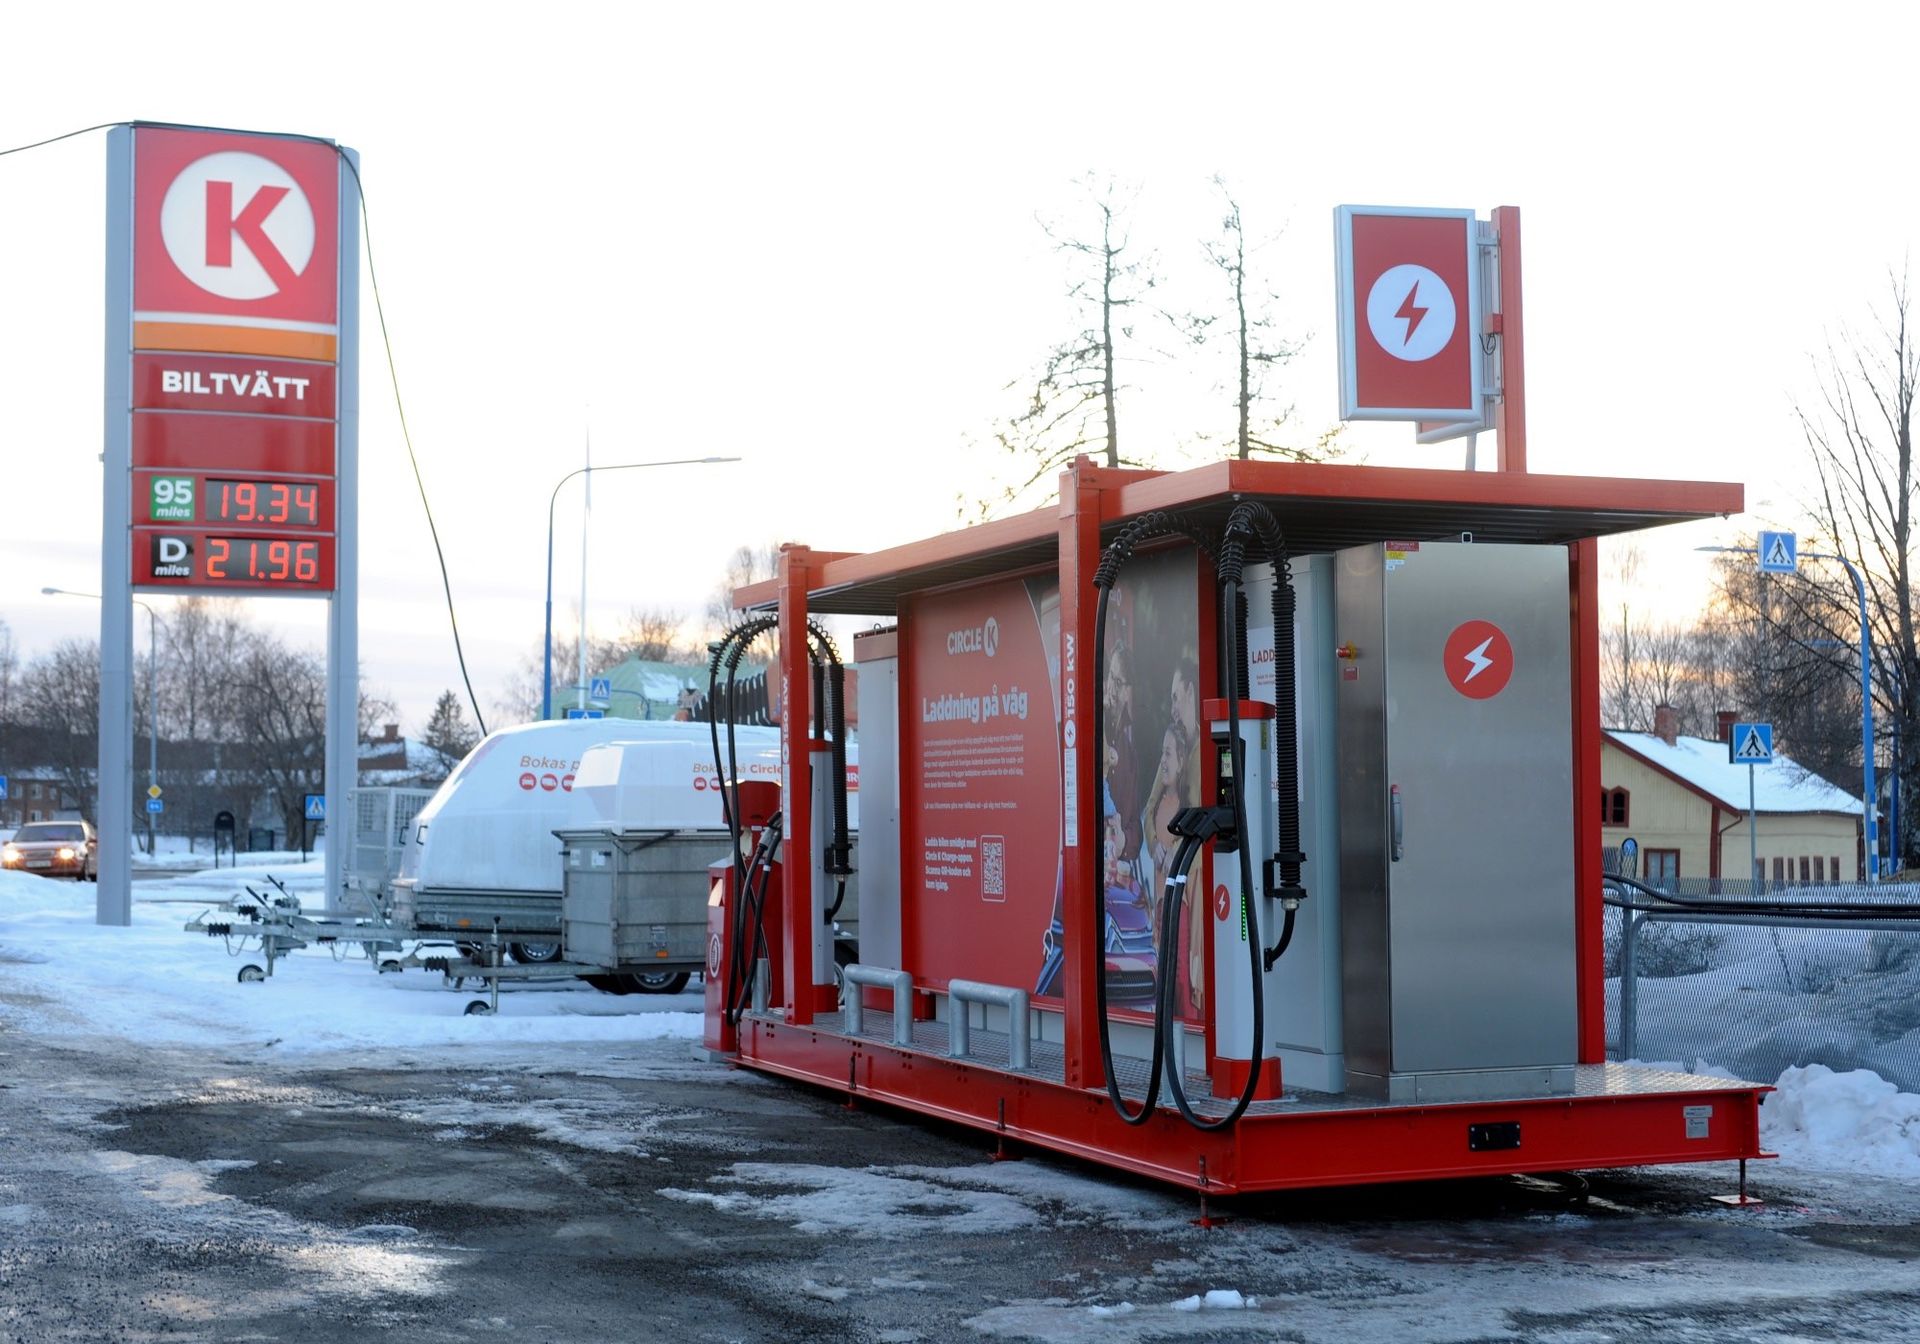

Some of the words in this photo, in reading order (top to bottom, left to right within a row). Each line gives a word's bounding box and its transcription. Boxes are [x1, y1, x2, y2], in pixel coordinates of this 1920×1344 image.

[205, 180, 300, 291] K
[162, 370, 310, 400] BILTVÄTT
[153, 480, 193, 505] 95
[220, 483, 317, 522] 19.34
[156, 506, 190, 518] miles
[159, 538, 188, 563] D
[206, 539, 317, 580] 21.96
[154, 564, 190, 577] miles
[947, 628, 982, 656] CIRCLE
[923, 692, 980, 723] Laddning
[983, 684, 999, 723] på
[1002, 686, 1028, 720] väg
[1066, 678, 1075, 718] 150
[520, 755, 567, 769] Bokas
